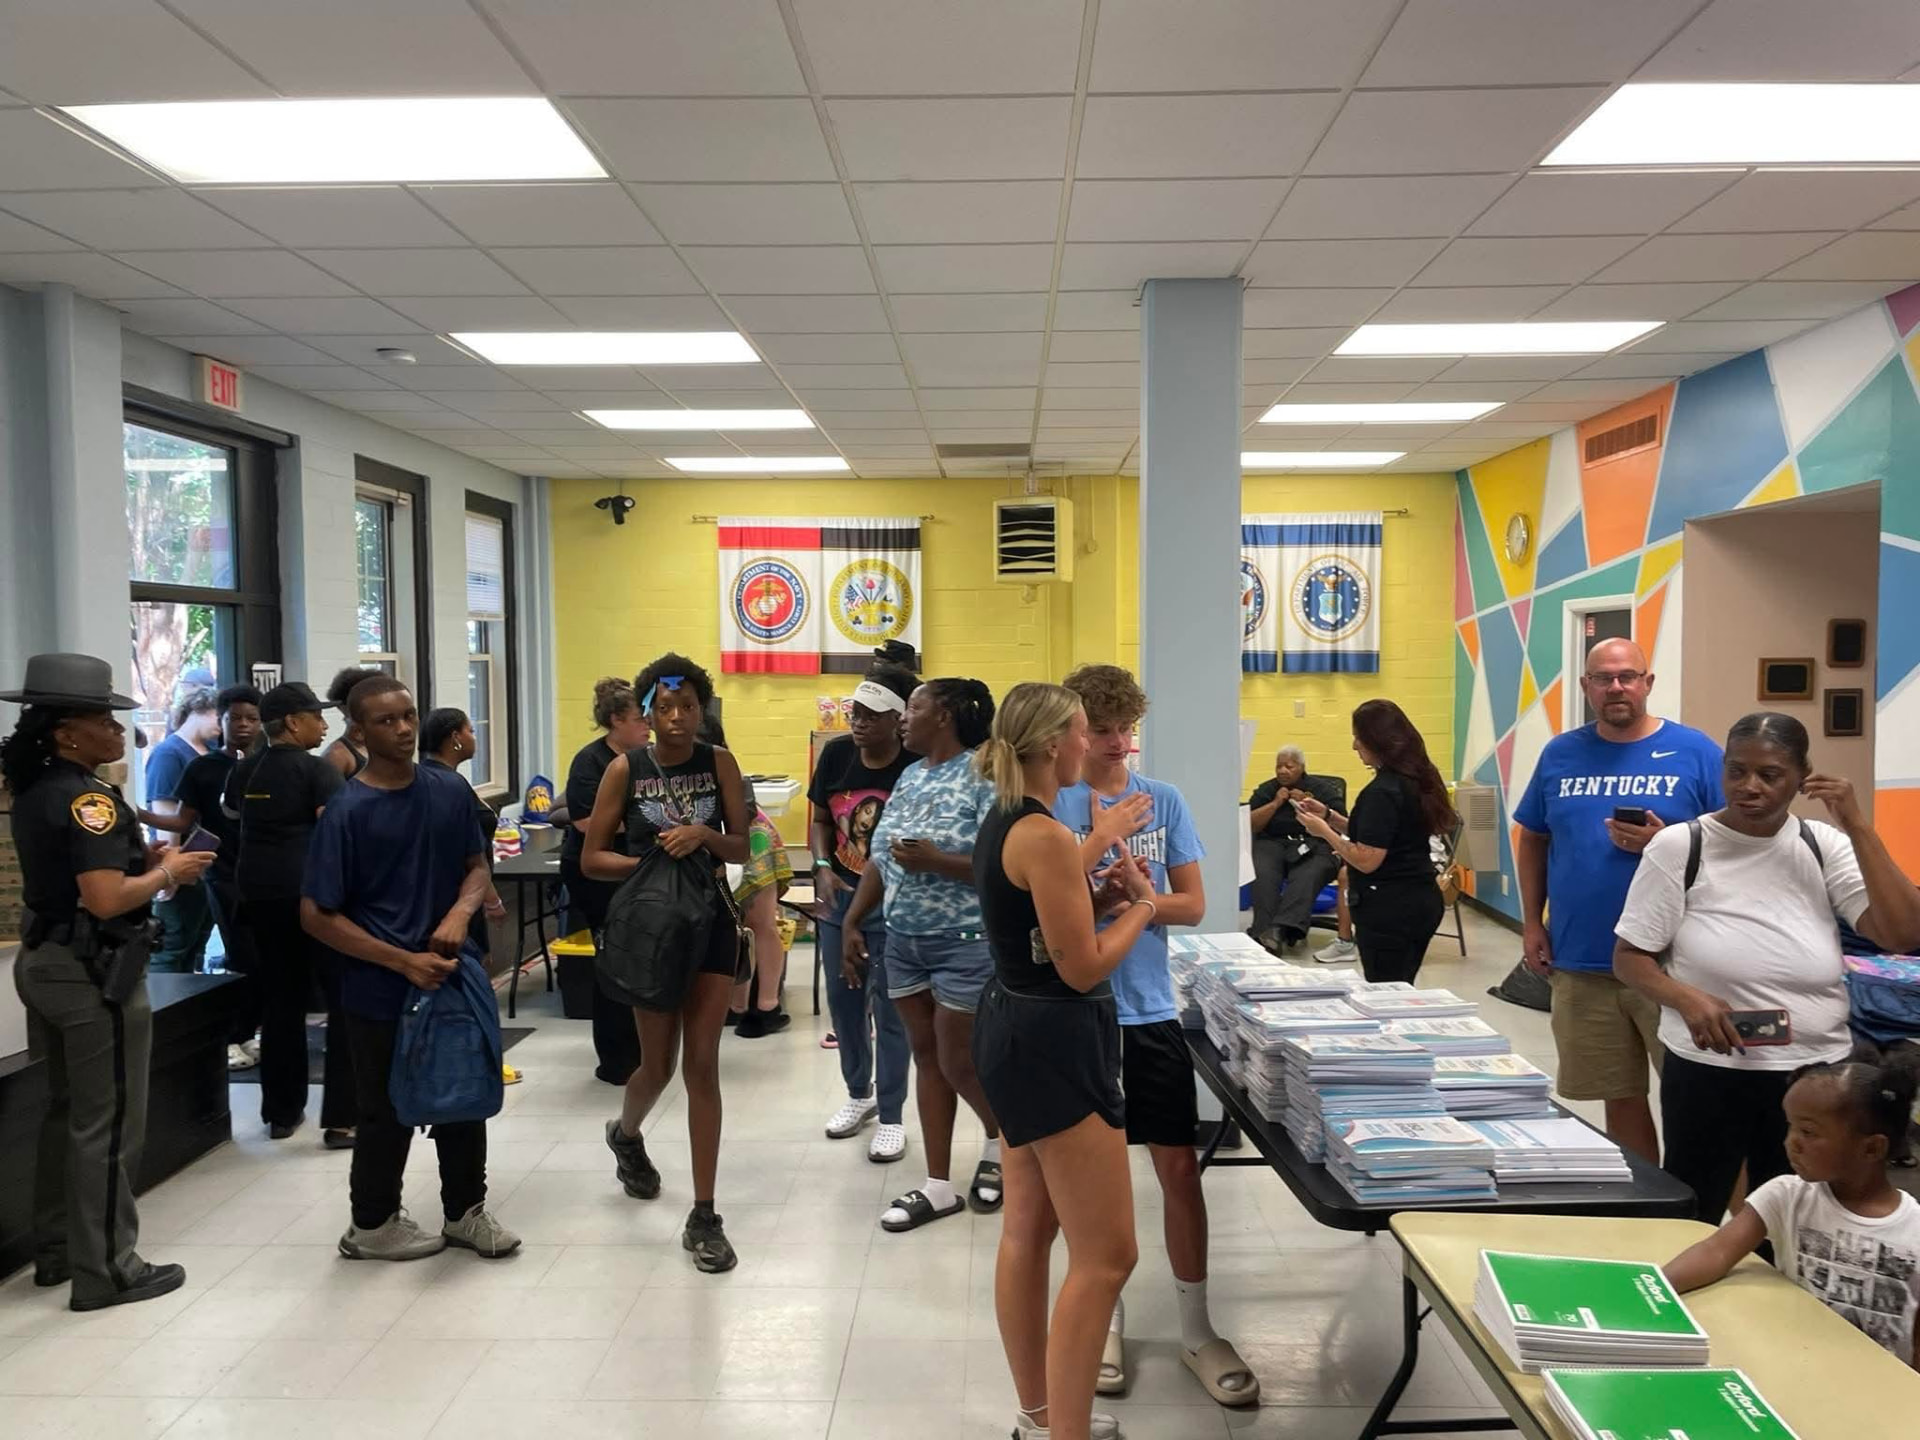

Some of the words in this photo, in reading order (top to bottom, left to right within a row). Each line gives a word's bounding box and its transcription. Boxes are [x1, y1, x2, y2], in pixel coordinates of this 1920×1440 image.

[210, 364, 237, 408] EXIT
[735, 562, 769, 600] DEPARTMENT
[789, 574, 804, 599] NAVY
[1558, 775, 1680, 798] KENTUCKY
[1640, 1273, 1671, 1303] Oxford
[1724, 1381, 1768, 1418] Oxford
